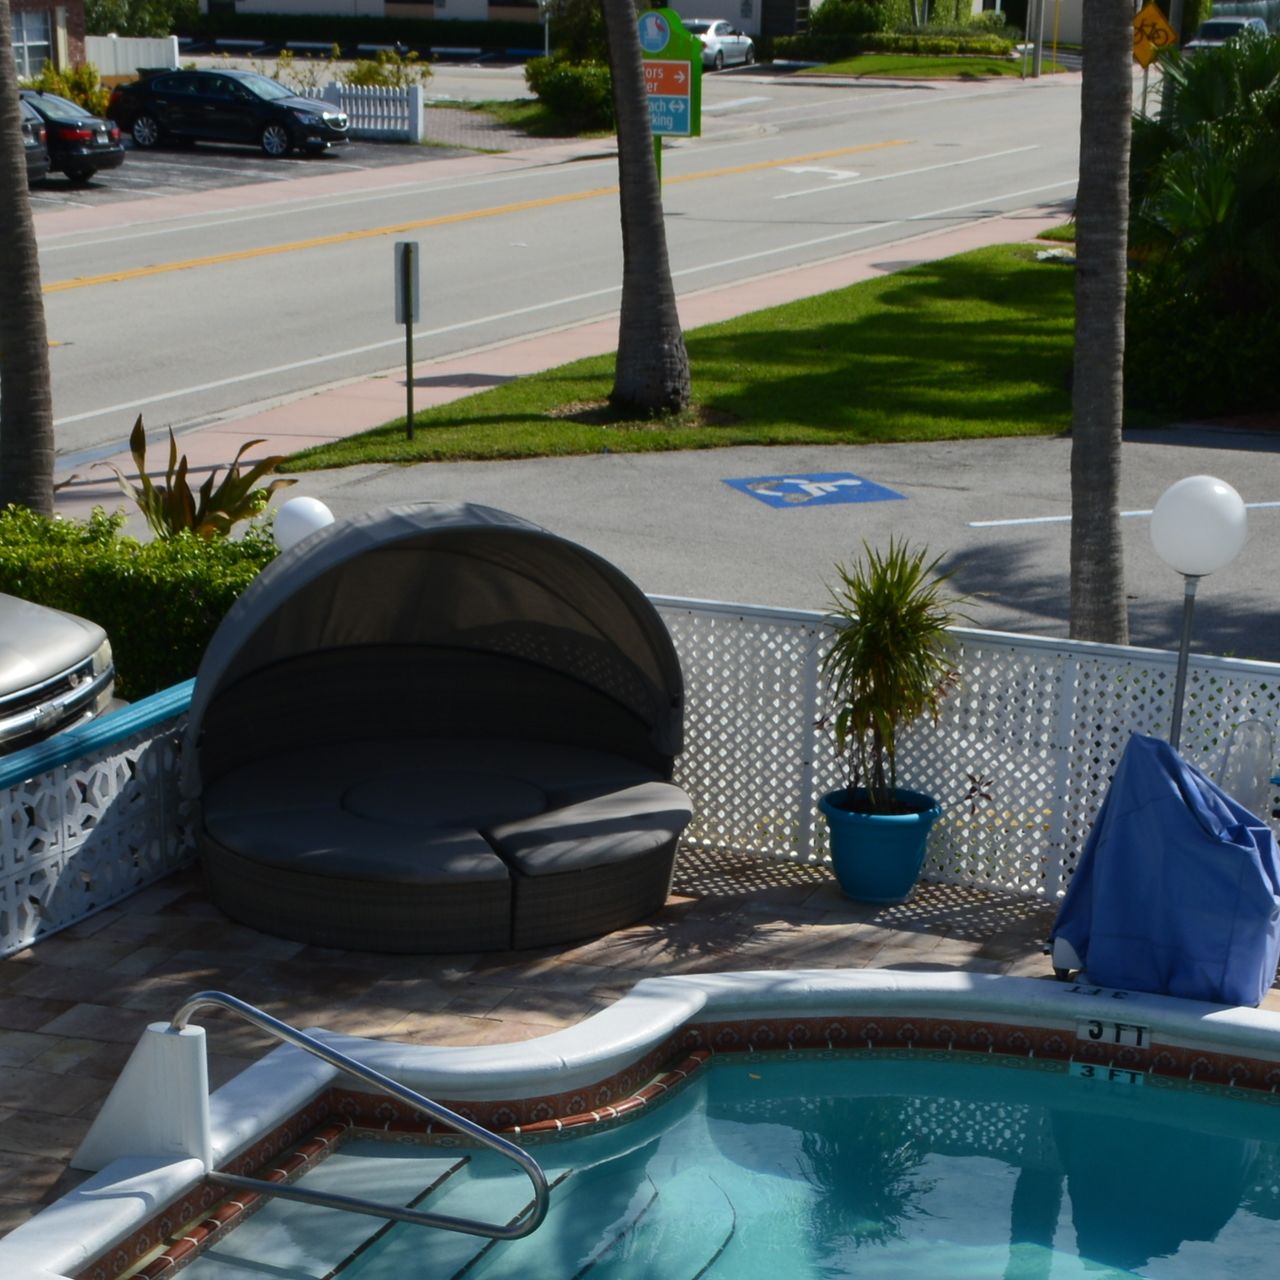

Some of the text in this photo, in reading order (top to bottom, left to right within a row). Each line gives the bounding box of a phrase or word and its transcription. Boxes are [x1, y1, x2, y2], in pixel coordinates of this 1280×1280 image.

[1088, 1019, 1148, 1047] 3 FT
[1080, 1065, 1143, 1084] 3 FT
